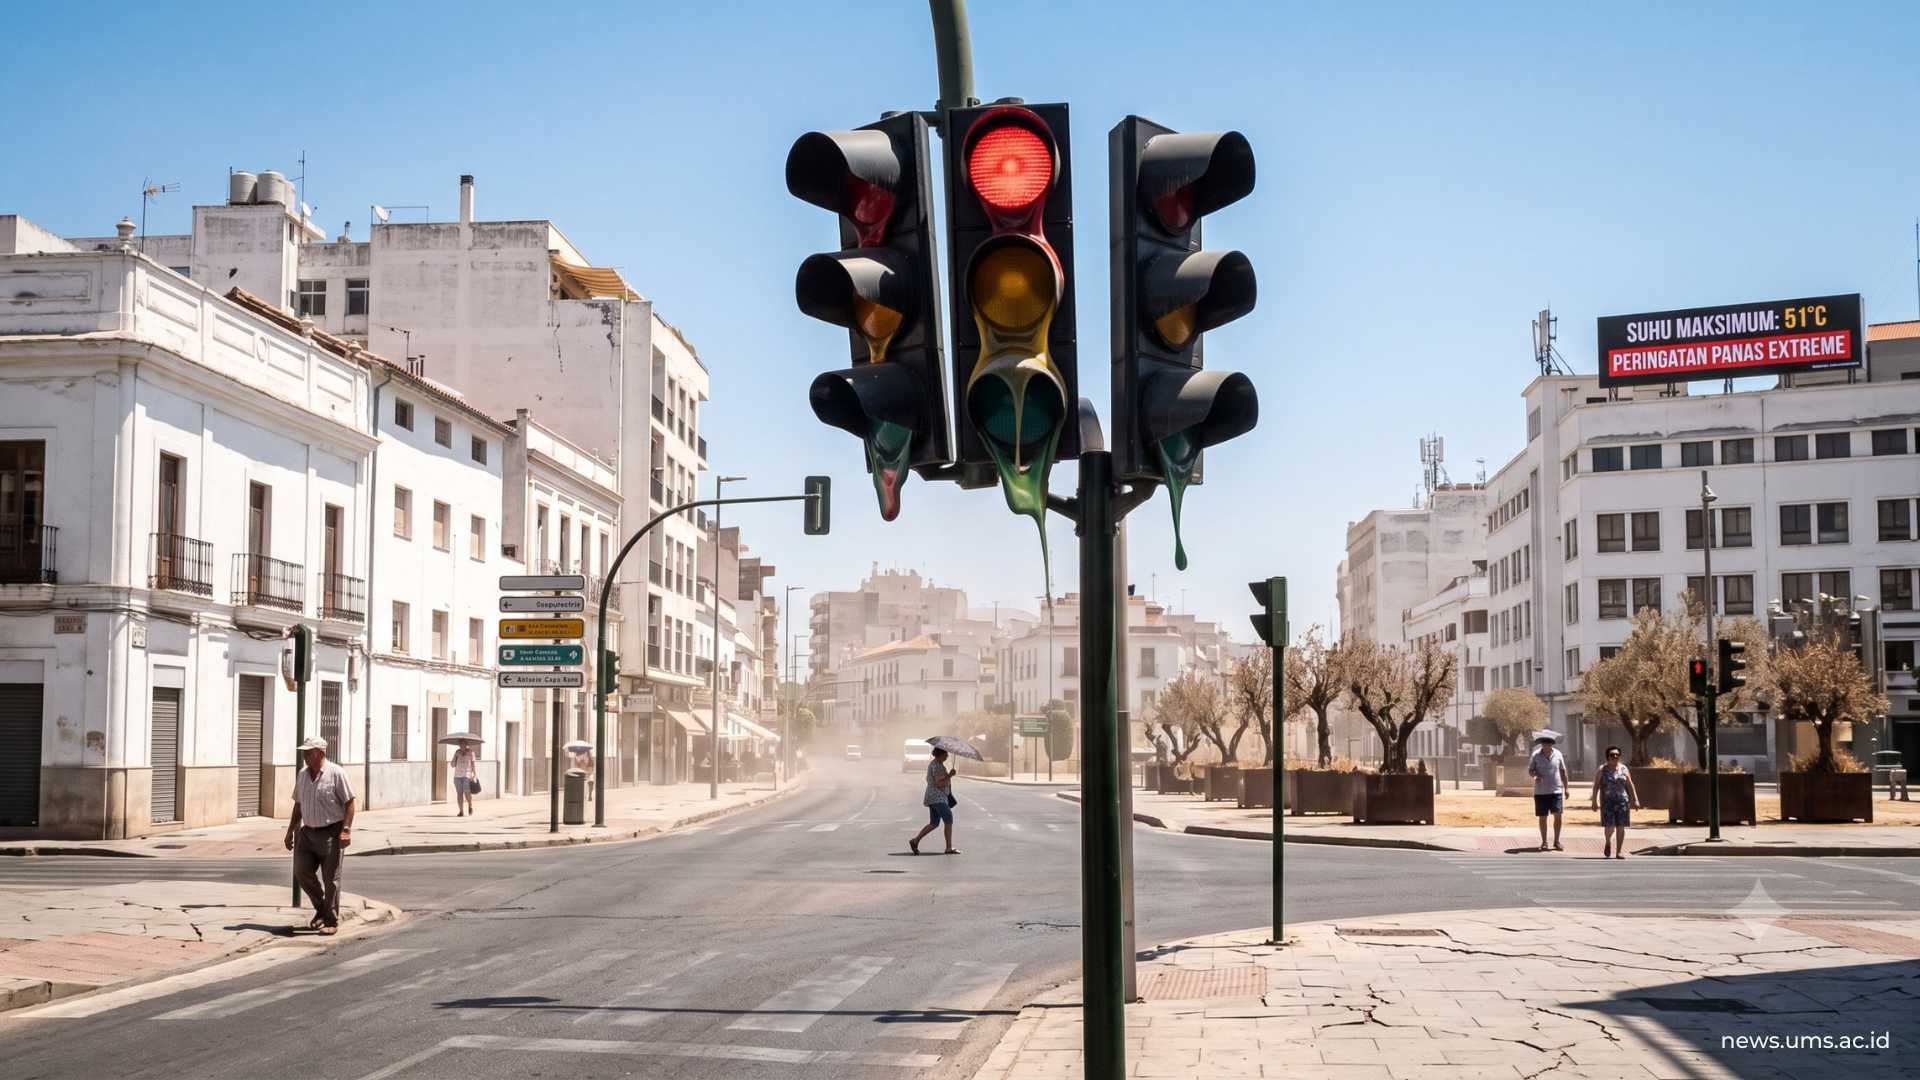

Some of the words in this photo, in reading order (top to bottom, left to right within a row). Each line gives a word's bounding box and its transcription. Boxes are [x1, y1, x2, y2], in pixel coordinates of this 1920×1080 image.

[1626, 319, 1671, 343] SUHU
[1676, 310, 1780, 338] MAKSIMUM:
[1784, 305, 1828, 329] 51°C
[1612, 348, 1708, 372] PERINGATAN
[1712, 342, 1764, 365] PANAS
[1768, 335, 1845, 359] EXTREME
